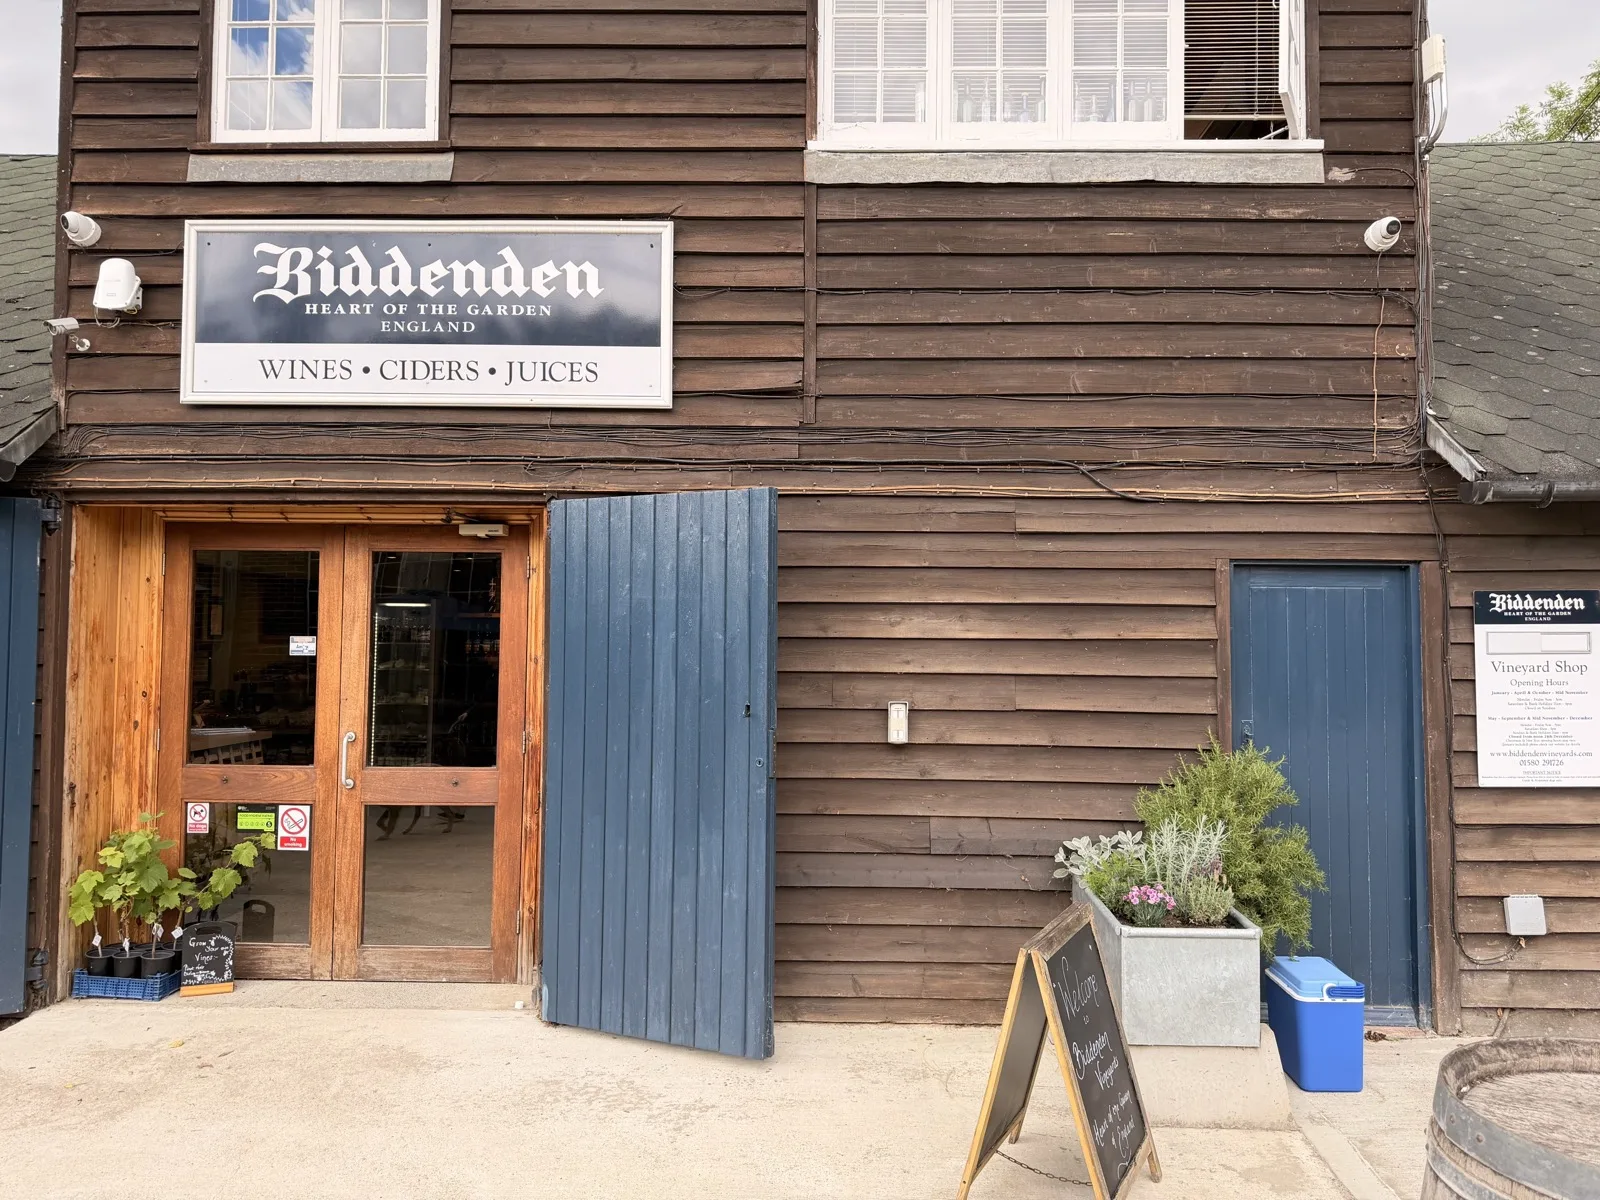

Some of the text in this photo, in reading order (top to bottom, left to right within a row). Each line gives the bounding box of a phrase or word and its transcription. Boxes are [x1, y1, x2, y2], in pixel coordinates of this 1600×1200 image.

[252, 242, 605, 304] Biddenden
[304, 303, 552, 316] HEART OF THE GARDEN
[380, 320, 476, 333] ENGLAND
[258, 359, 352, 381] WINES
[379, 359, 479, 382] CIDERS
[504, 360, 599, 387] JUICES
[1488, 593, 1585, 613] Biddenden
[1491, 660, 1588, 675] Vineyard Shop
[1510, 679, 1569, 688] Opening Hours
[1490, 750, 1593, 759] www.biddendenvineyards.com
[189, 936, 207, 947] Grow
[1057, 956, 1100, 1022] Welcome
[1072, 1031, 1113, 1080] Biddenden
[1094, 1055, 1119, 1091] Vineyards
